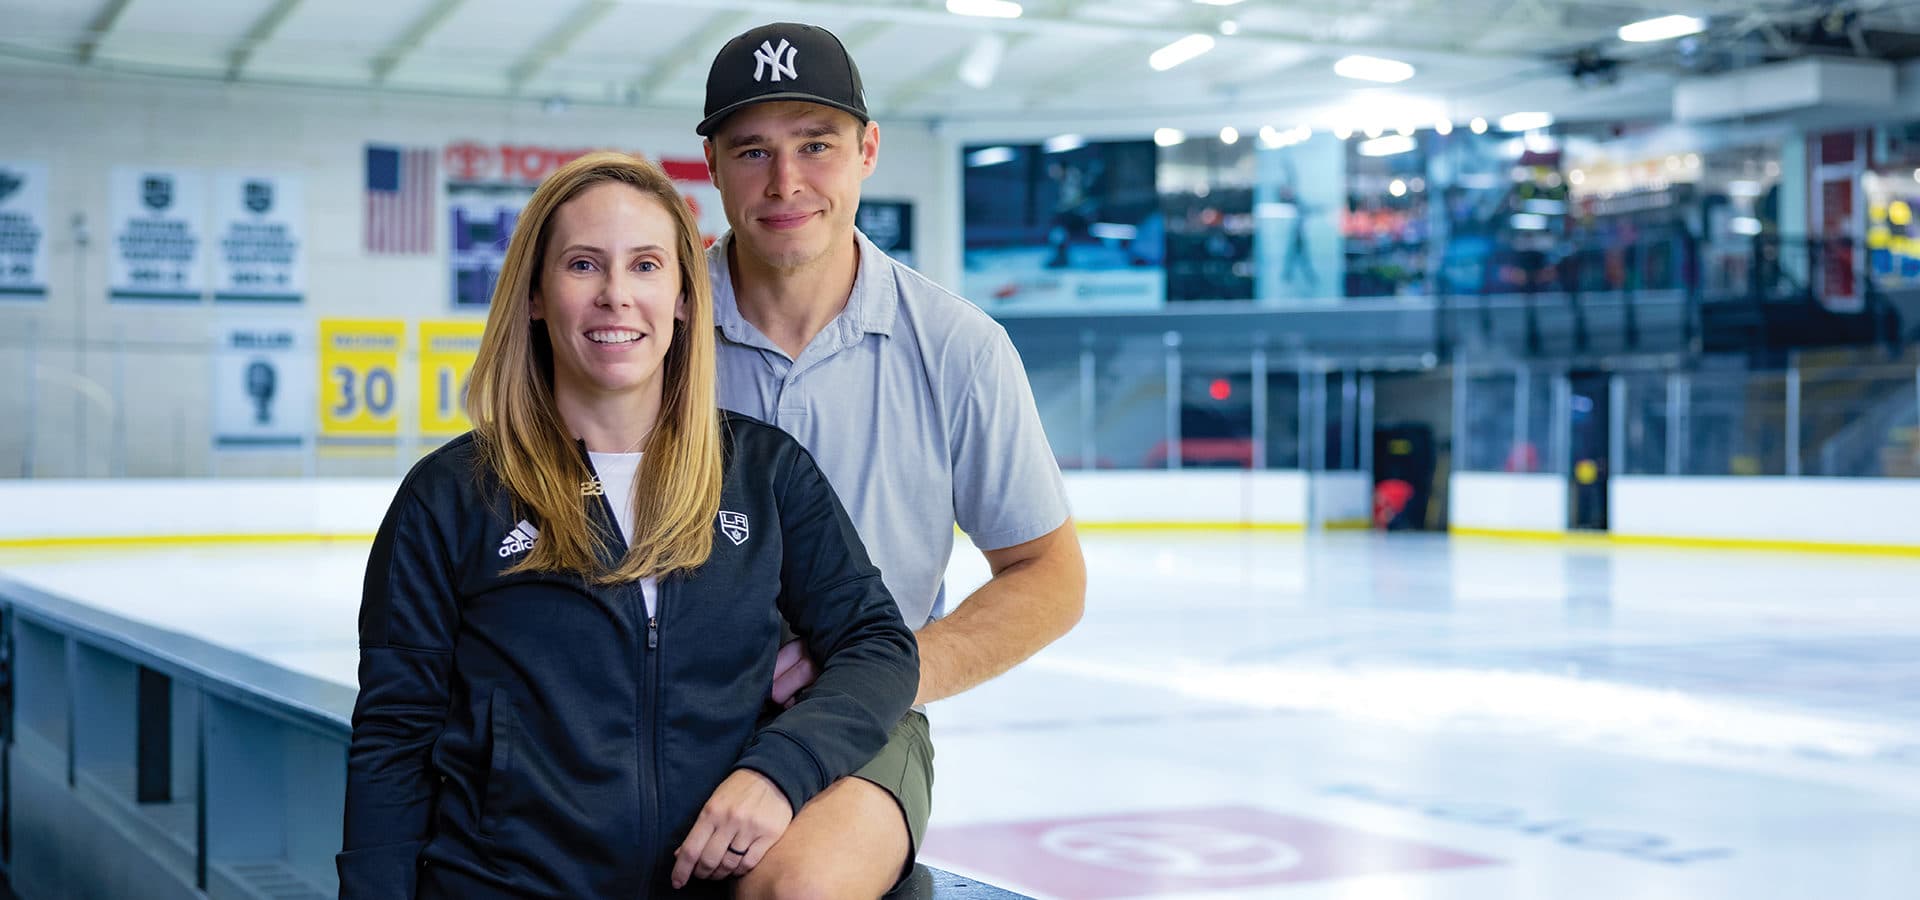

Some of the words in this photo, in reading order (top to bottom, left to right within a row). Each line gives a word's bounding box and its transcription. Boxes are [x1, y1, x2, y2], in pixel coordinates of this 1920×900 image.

[753, 38, 799, 82] NY
[335, 366, 394, 417] 30
[722, 513, 747, 527] LA
